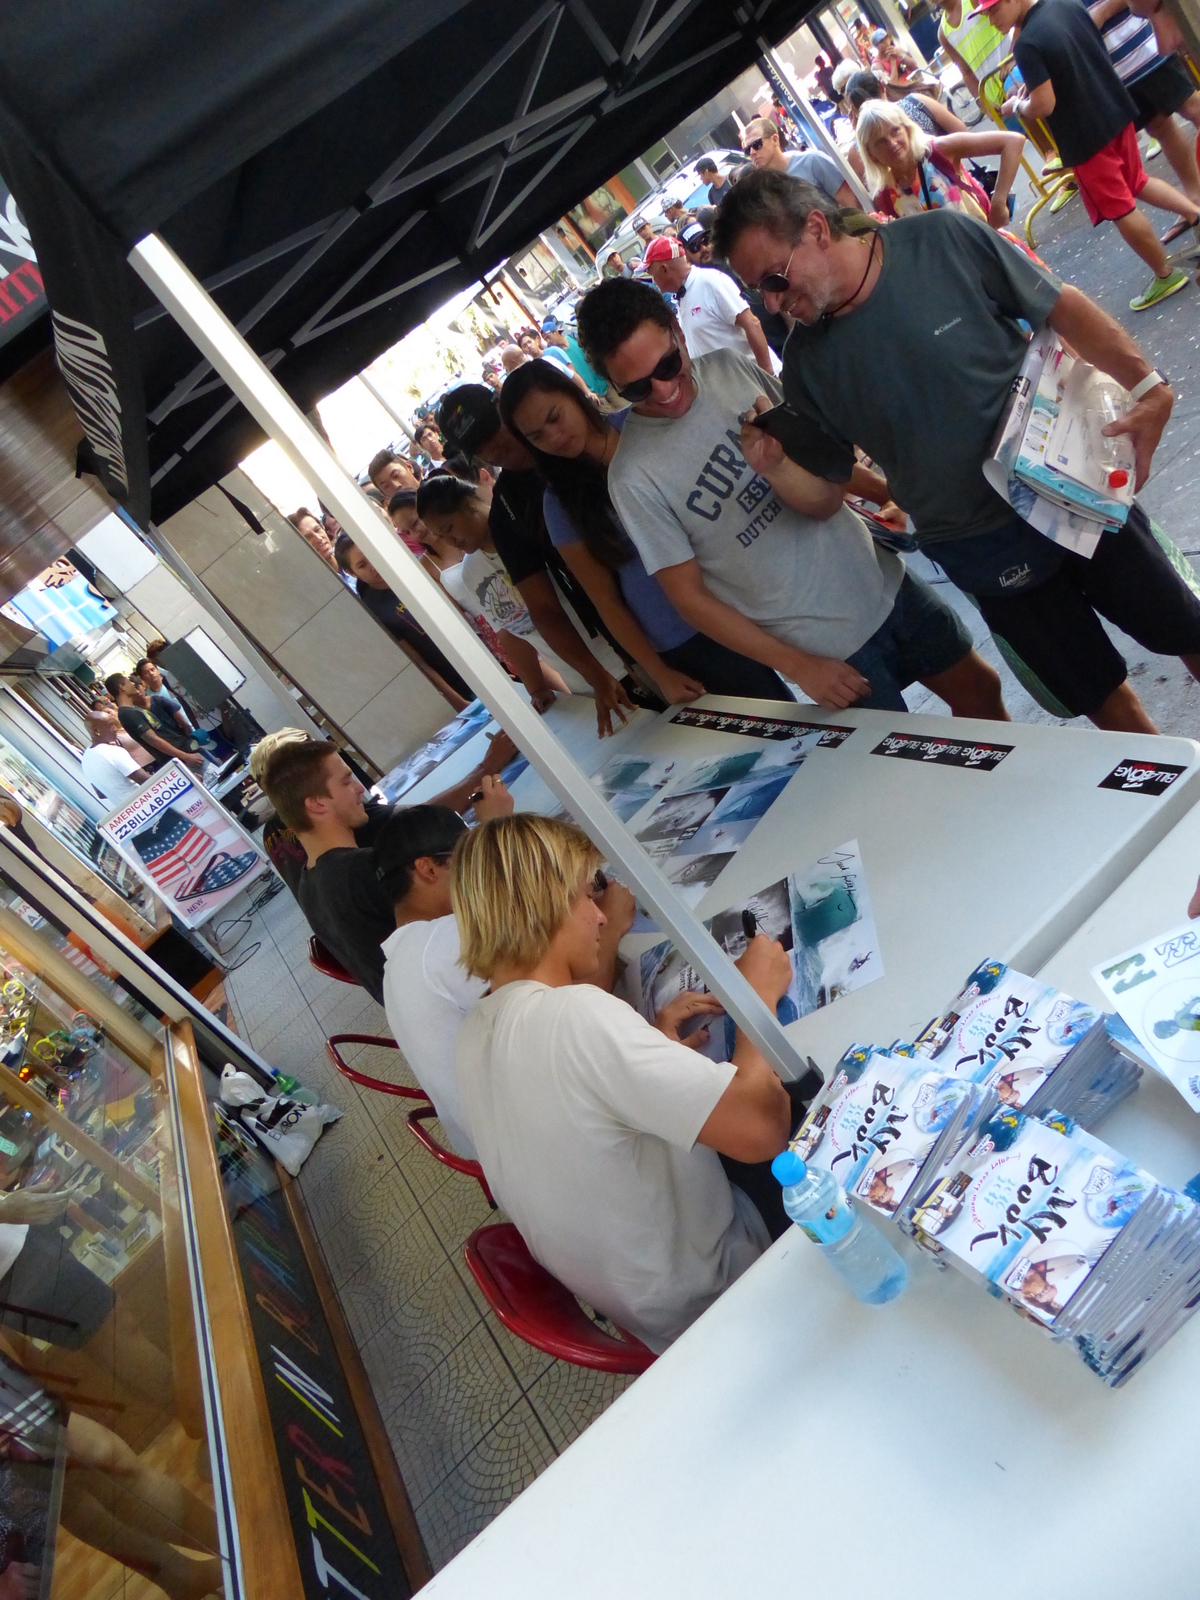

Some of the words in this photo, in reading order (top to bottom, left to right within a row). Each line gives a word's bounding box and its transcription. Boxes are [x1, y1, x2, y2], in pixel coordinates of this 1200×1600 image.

[109, 792, 152, 831] AMERICAN
[153, 770, 179, 794] STYLE
[1114, 765, 1179, 784] BILLABONG
[127, 777, 187, 834] BILLABONG
[186, 799, 203, 816] NEW
[186, 899, 204, 914] NEW
[955, 994, 1029, 1071] Book
[830, 1080, 896, 1171] Book
[969, 1153, 1059, 1252] Book
[1020, 1186, 1078, 1245] My
[270, 1344, 344, 1438] IN
[287, 1421, 382, 1600] TTER
